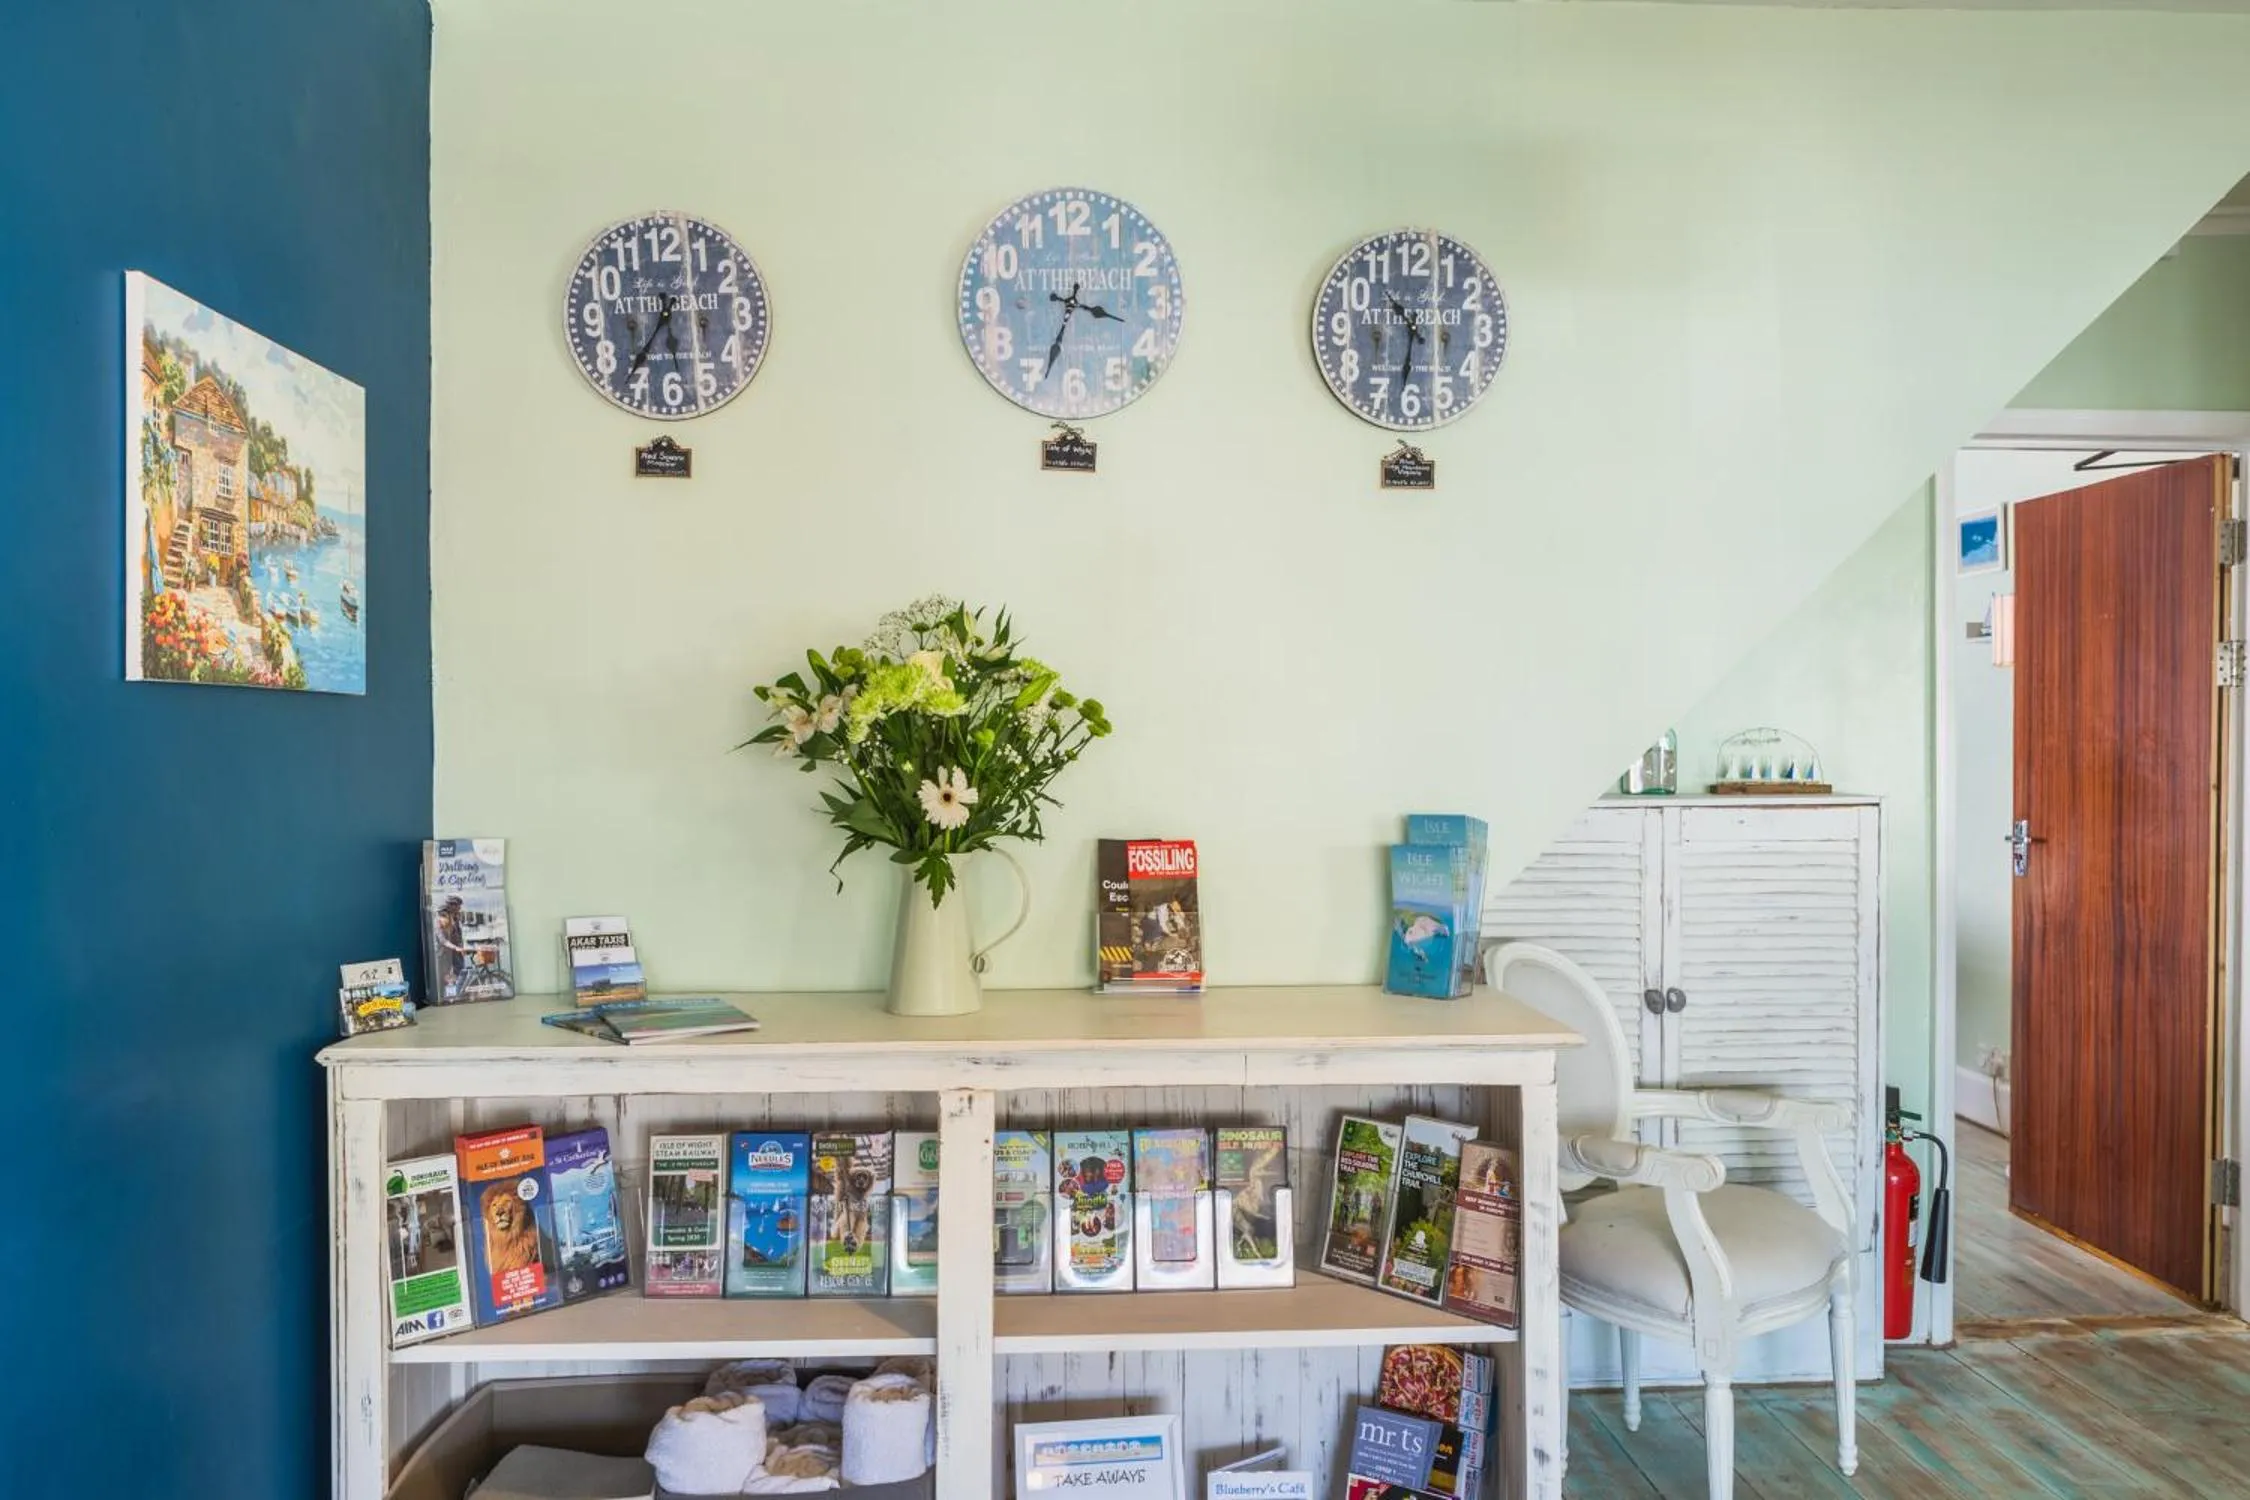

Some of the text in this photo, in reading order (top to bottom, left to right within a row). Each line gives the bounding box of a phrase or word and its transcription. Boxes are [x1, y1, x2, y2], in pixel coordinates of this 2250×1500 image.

[1016, 214, 1044, 250] 11
[1049, 200, 1092, 236] 12
[1102, 213, 1121, 250] 1
[611, 236, 641, 272] 11
[645, 227, 682, 262] 12
[692, 237, 708, 272] 1
[1133, 242, 1159, 278] 2
[1396, 242, 1431, 278] 12
[717, 259, 739, 294] 2
[981, 244, 1018, 281] 10
[1014, 267, 1133, 291] AT THE BEACH
[1363, 250, 1390, 284] 11
[1441, 254, 1456, 288] 1
[585, 265, 621, 301] 10
[1338, 277, 1371, 312] 10
[1462, 277, 1483, 311] 2
[583, 302, 603, 337] 9
[614, 293, 719, 314] AT TH BEACH
[733, 297, 753, 332] 3
[976, 287, 1000, 322] 9
[1148, 285, 1172, 321] 3
[1361, 308, 1382, 325] AT
[1416, 308, 1462, 325] BEACH
[988, 326, 1013, 362] 8
[1132, 328, 1159, 363] 4
[1331, 311, 1351, 346] 9
[1473, 313, 1493, 348] 3
[596, 340, 617, 375] 8
[720, 335, 739, 368] 4
[1340, 348, 1360, 383] 8
[1458, 349, 1478, 384] 4
[662, 371, 684, 406] 6
[699, 363, 718, 398] 5
[1019, 358, 1045, 393] 7
[1062, 368, 1087, 404] 6
[1105, 356, 1130, 392] 5
[1369, 378, 1390, 411] 7
[1400, 383, 1421, 417] 6
[1435, 376, 1454, 411] 5
[1128, 847, 1196, 873] FOSSILING
[1218, 1130, 1284, 1141] DINOSAUR
[1404, 1151, 1438, 1166] EXPLORE
[1402, 1169, 1441, 1185] CHURCHILL
[395, 1319, 426, 1338] AIM
[1055, 1469, 1147, 1487] TAKE AWAYS
[1215, 1482, 1276, 1496] Blueberry's
